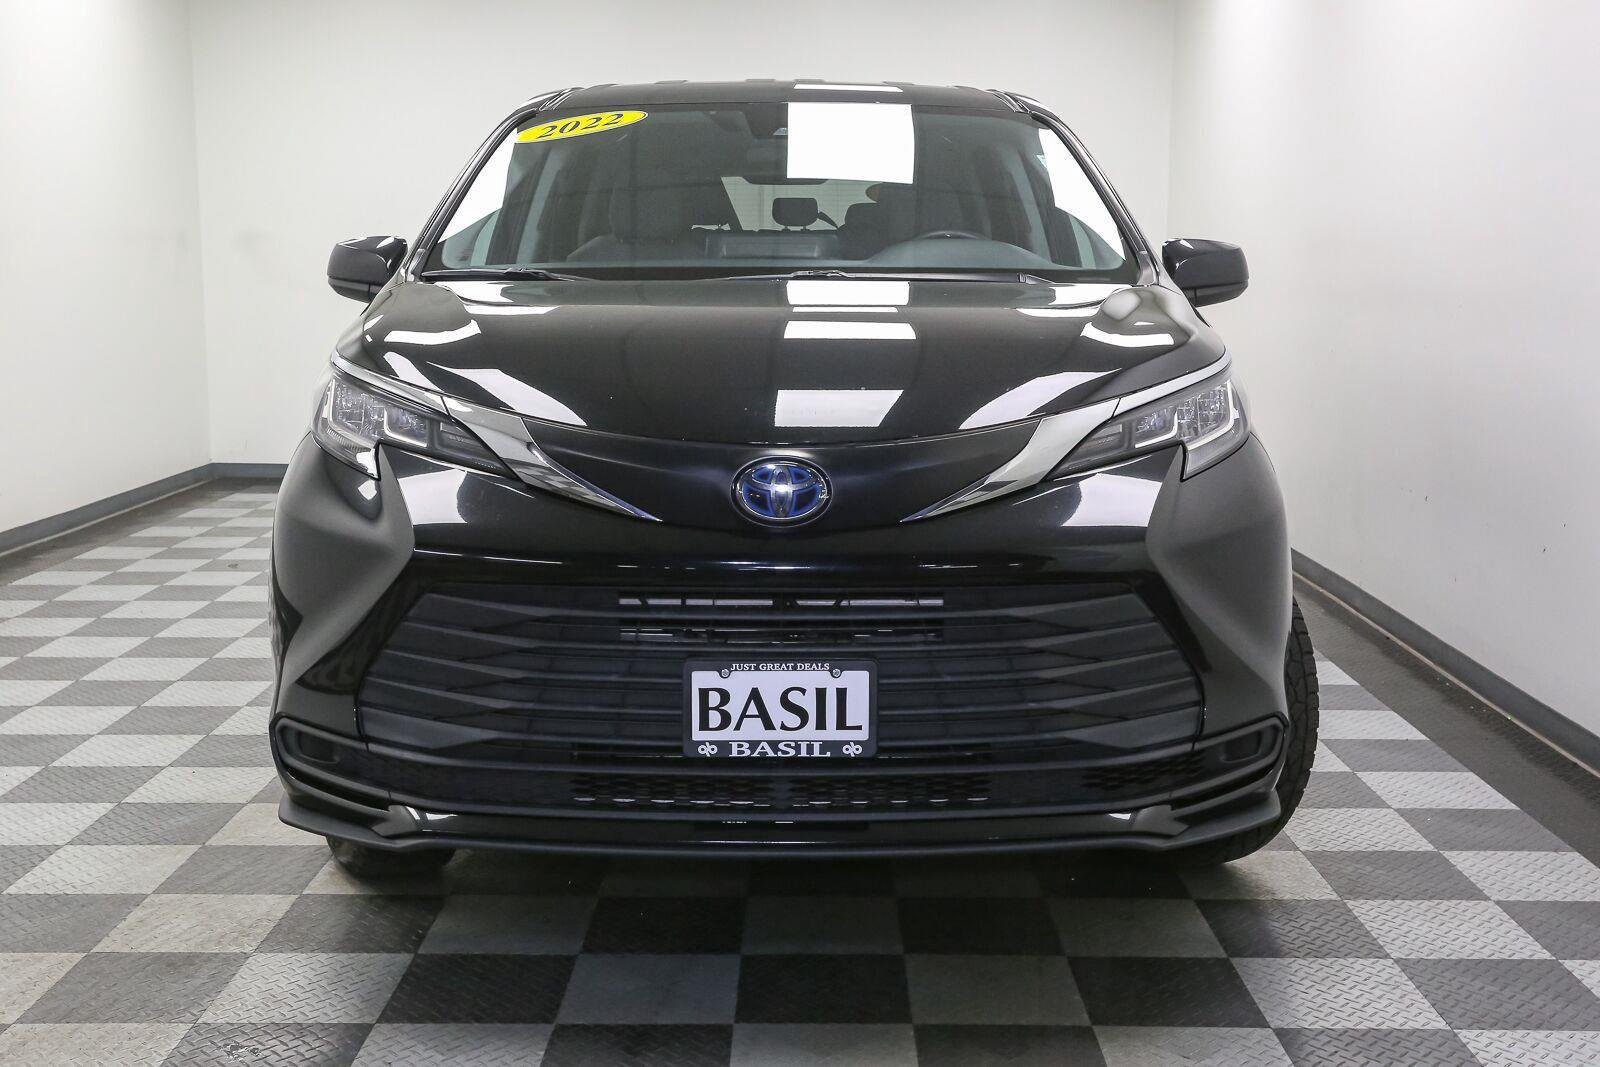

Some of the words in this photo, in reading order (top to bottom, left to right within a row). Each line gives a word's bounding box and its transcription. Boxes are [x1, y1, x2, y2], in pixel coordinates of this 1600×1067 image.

[536, 113, 624, 139] 2022
[730, 663, 756, 671] JUST
[759, 663, 795, 671] GREAT
[796, 663, 830, 671] DEALS
[698, 686, 863, 731] BASIL
[728, 741, 831, 757] BASIL
